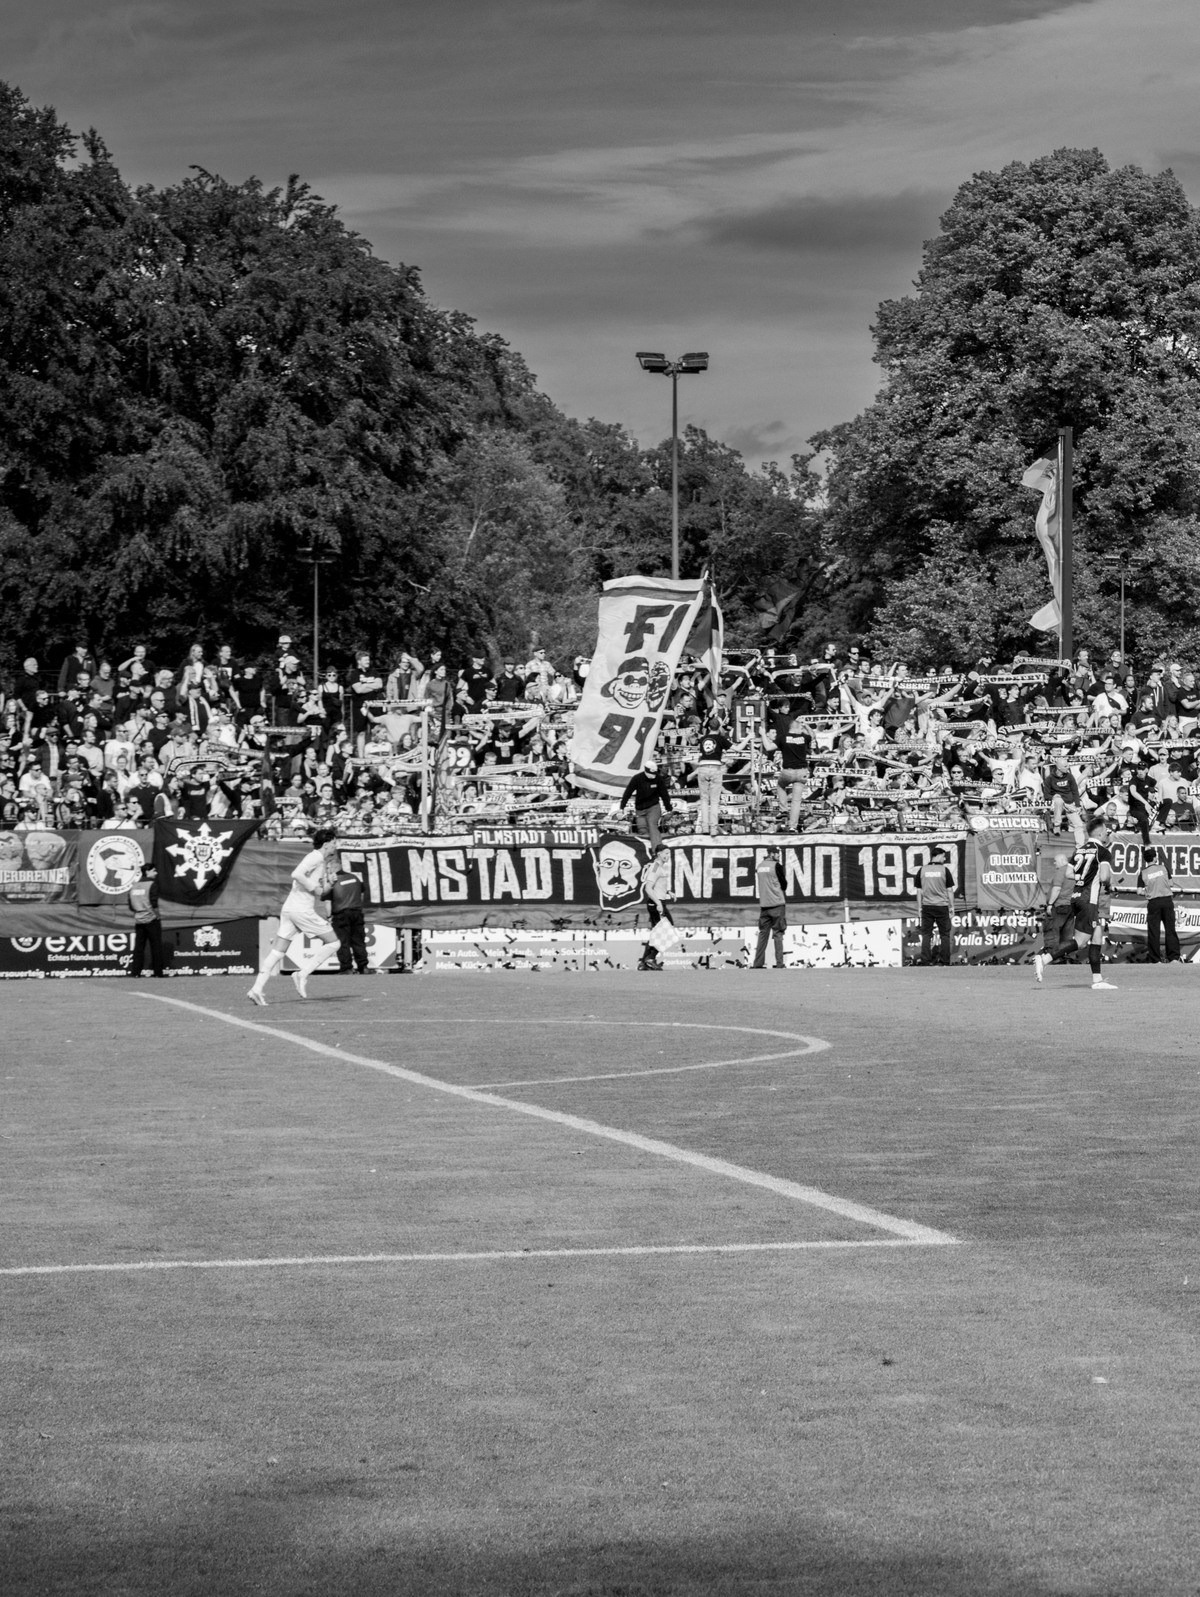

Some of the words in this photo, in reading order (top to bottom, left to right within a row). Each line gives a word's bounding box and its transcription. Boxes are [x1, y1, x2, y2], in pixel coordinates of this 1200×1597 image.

[624, 604, 691, 653] FI
[869, 680, 931, 690] BABESBERG
[989, 817, 1040, 830] CHICOS
[474, 829, 546, 844] FILMSTADT
[551, 829, 598, 844] YOUTH
[982, 872, 1002, 884] FÜR
[1004, 872, 1038, 884] IMMER.
[953, 933, 983, 946] Yalla
[984, 932, 1015, 946] SVB!
[50, 968, 92, 978] regionale
[92, 968, 127, 976] Zutaten
